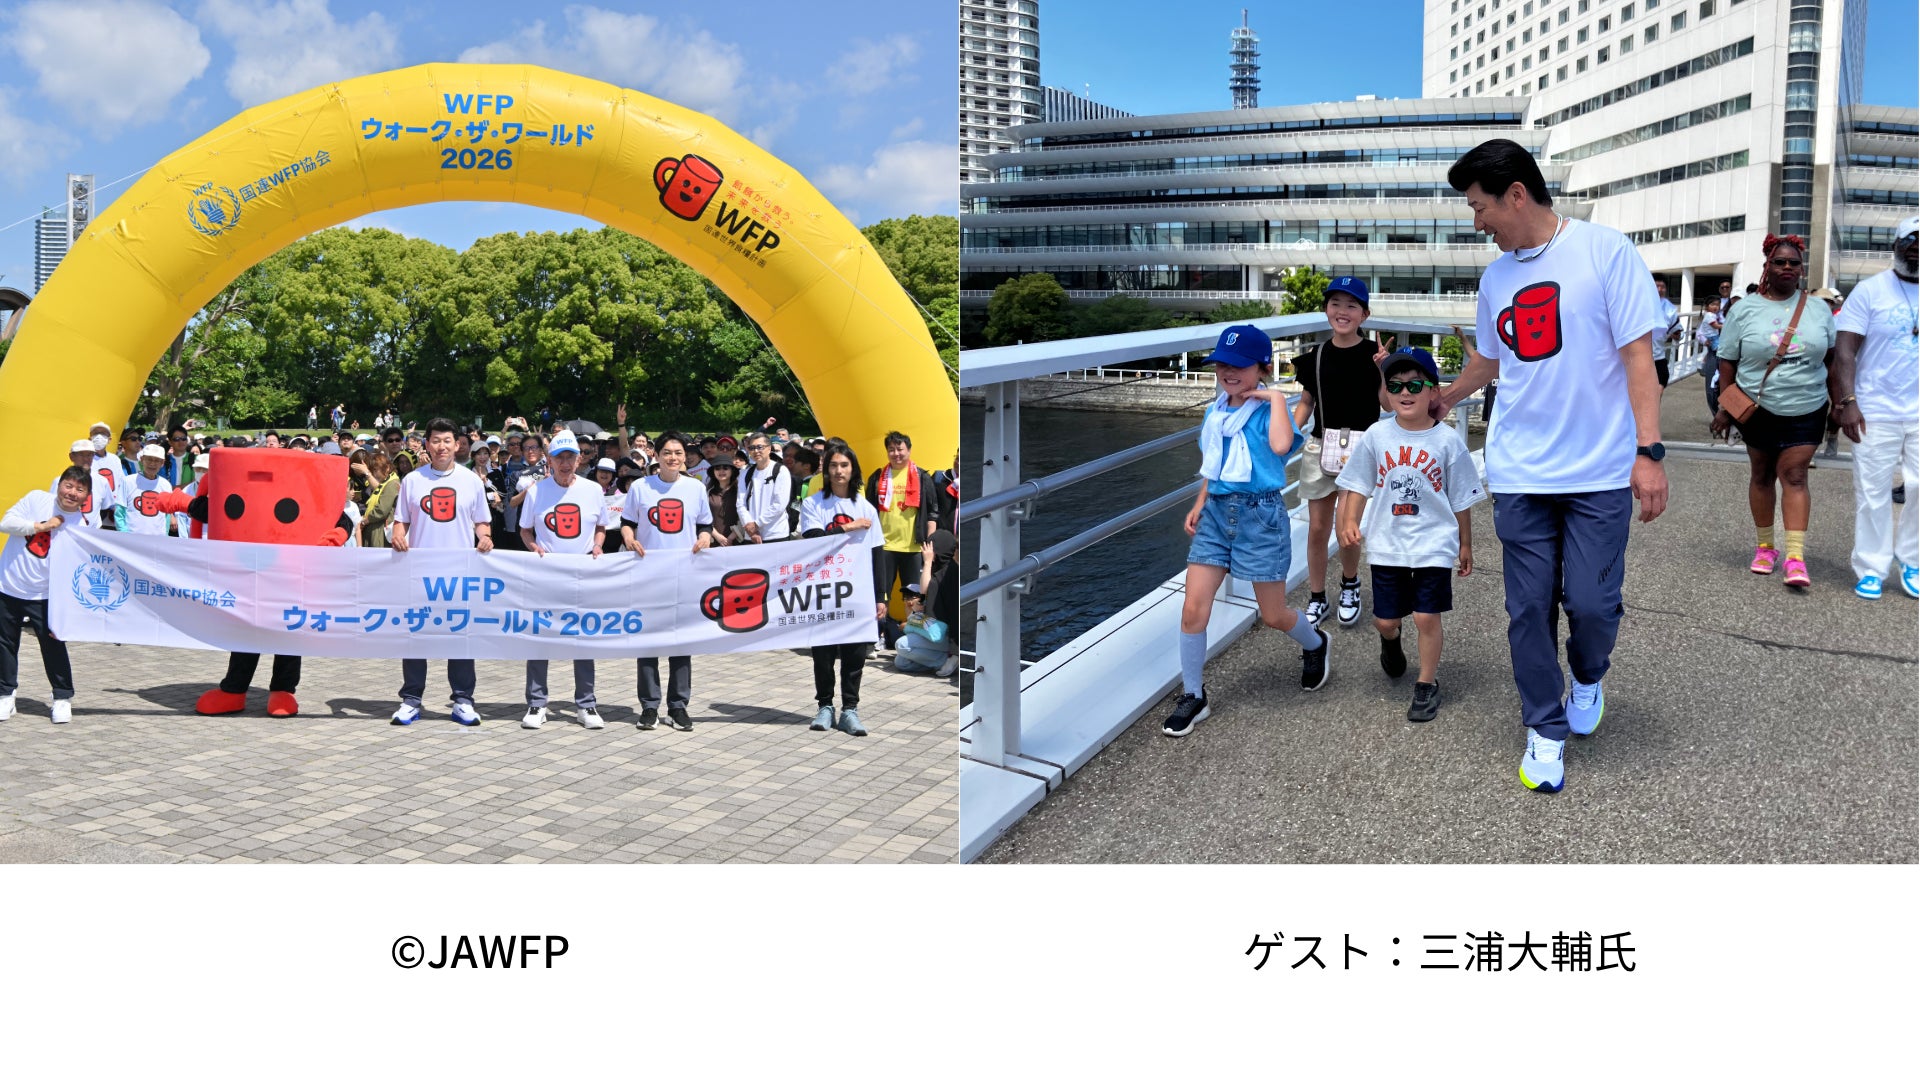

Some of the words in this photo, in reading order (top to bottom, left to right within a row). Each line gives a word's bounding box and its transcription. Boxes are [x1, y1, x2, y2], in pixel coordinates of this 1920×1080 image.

[443, 93, 514, 115] WFP
[361, 117, 595, 147] ウォーク・ザ・ワールド
[440, 148, 513, 170] 2026
[192, 181, 213, 197] WFP
[238, 149, 331, 202] 国連WFP協会
[726, 191, 784, 231] 未来を救う
[715, 201, 780, 253] WFP
[90, 554, 113, 565] WFP
[134, 578, 236, 608] 国連WFP協会
[422, 576, 506, 602] WFP
[777, 580, 854, 614] WFP
[283, 605, 553, 634] ウォーク・ザ・ワールド
[559, 610, 643, 636] 2026
[777, 610, 855, 627] 国連世界食糧計画
